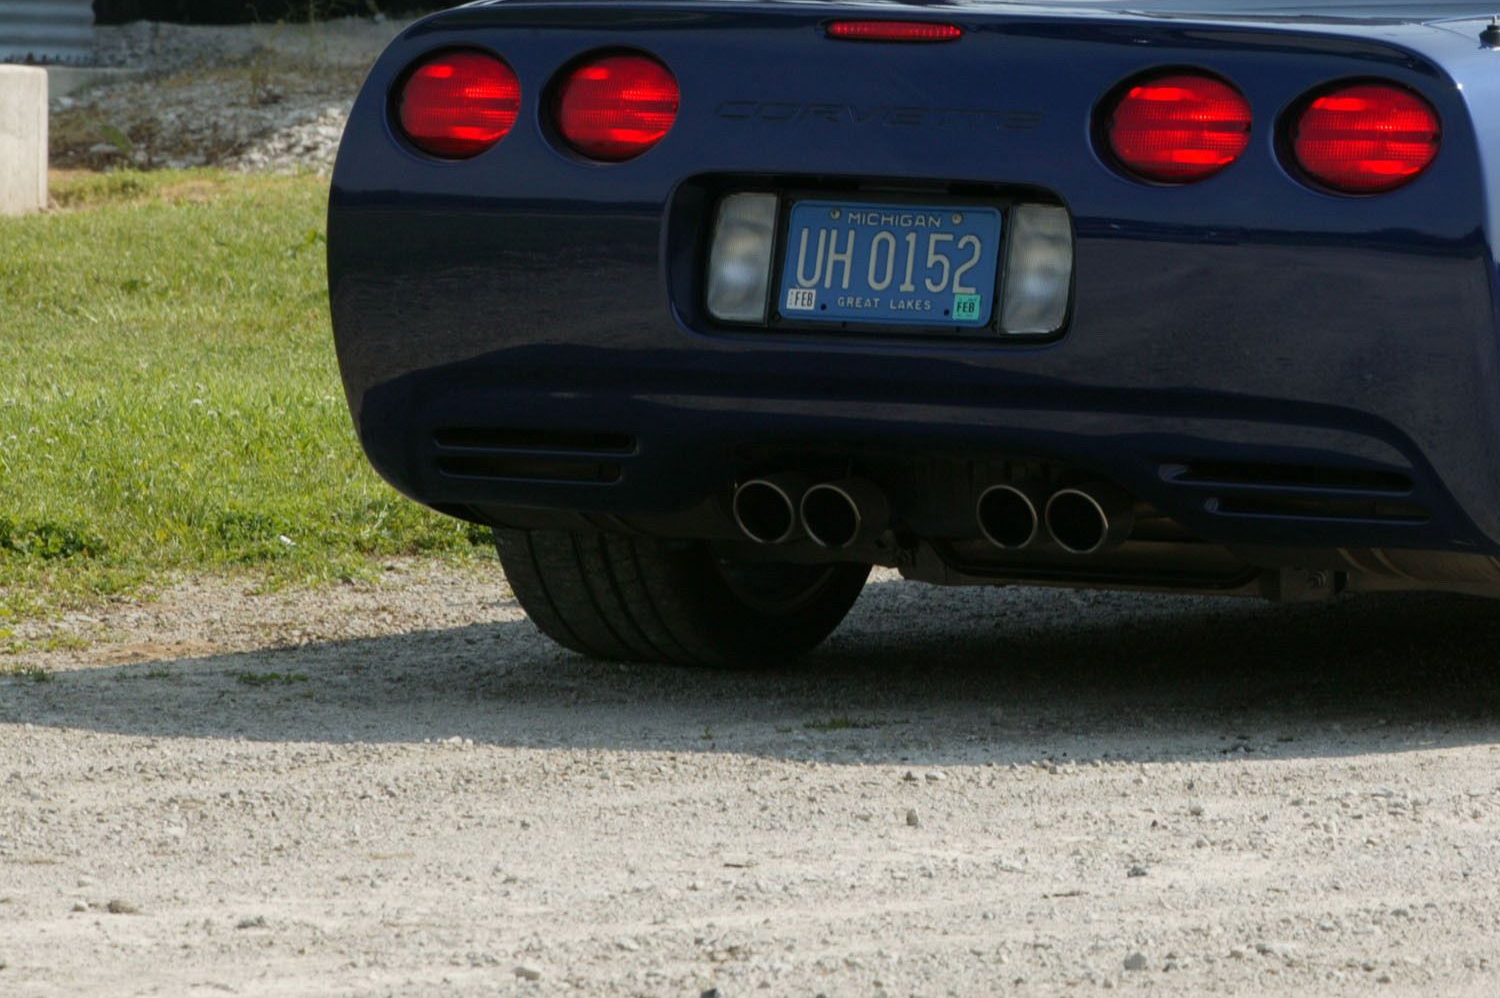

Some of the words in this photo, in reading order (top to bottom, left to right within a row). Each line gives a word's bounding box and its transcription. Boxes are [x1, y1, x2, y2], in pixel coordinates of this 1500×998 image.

[717, 101, 1042, 130] CORVETTE
[848, 212, 942, 227] MICHIGAN
[796, 228, 855, 290] UH
[867, 230, 982, 294] 0152
[794, 291, 813, 307] FEB
[837, 296, 880, 308] GREAT
[889, 298, 931, 311] LAKES
[956, 301, 975, 313] FEB
